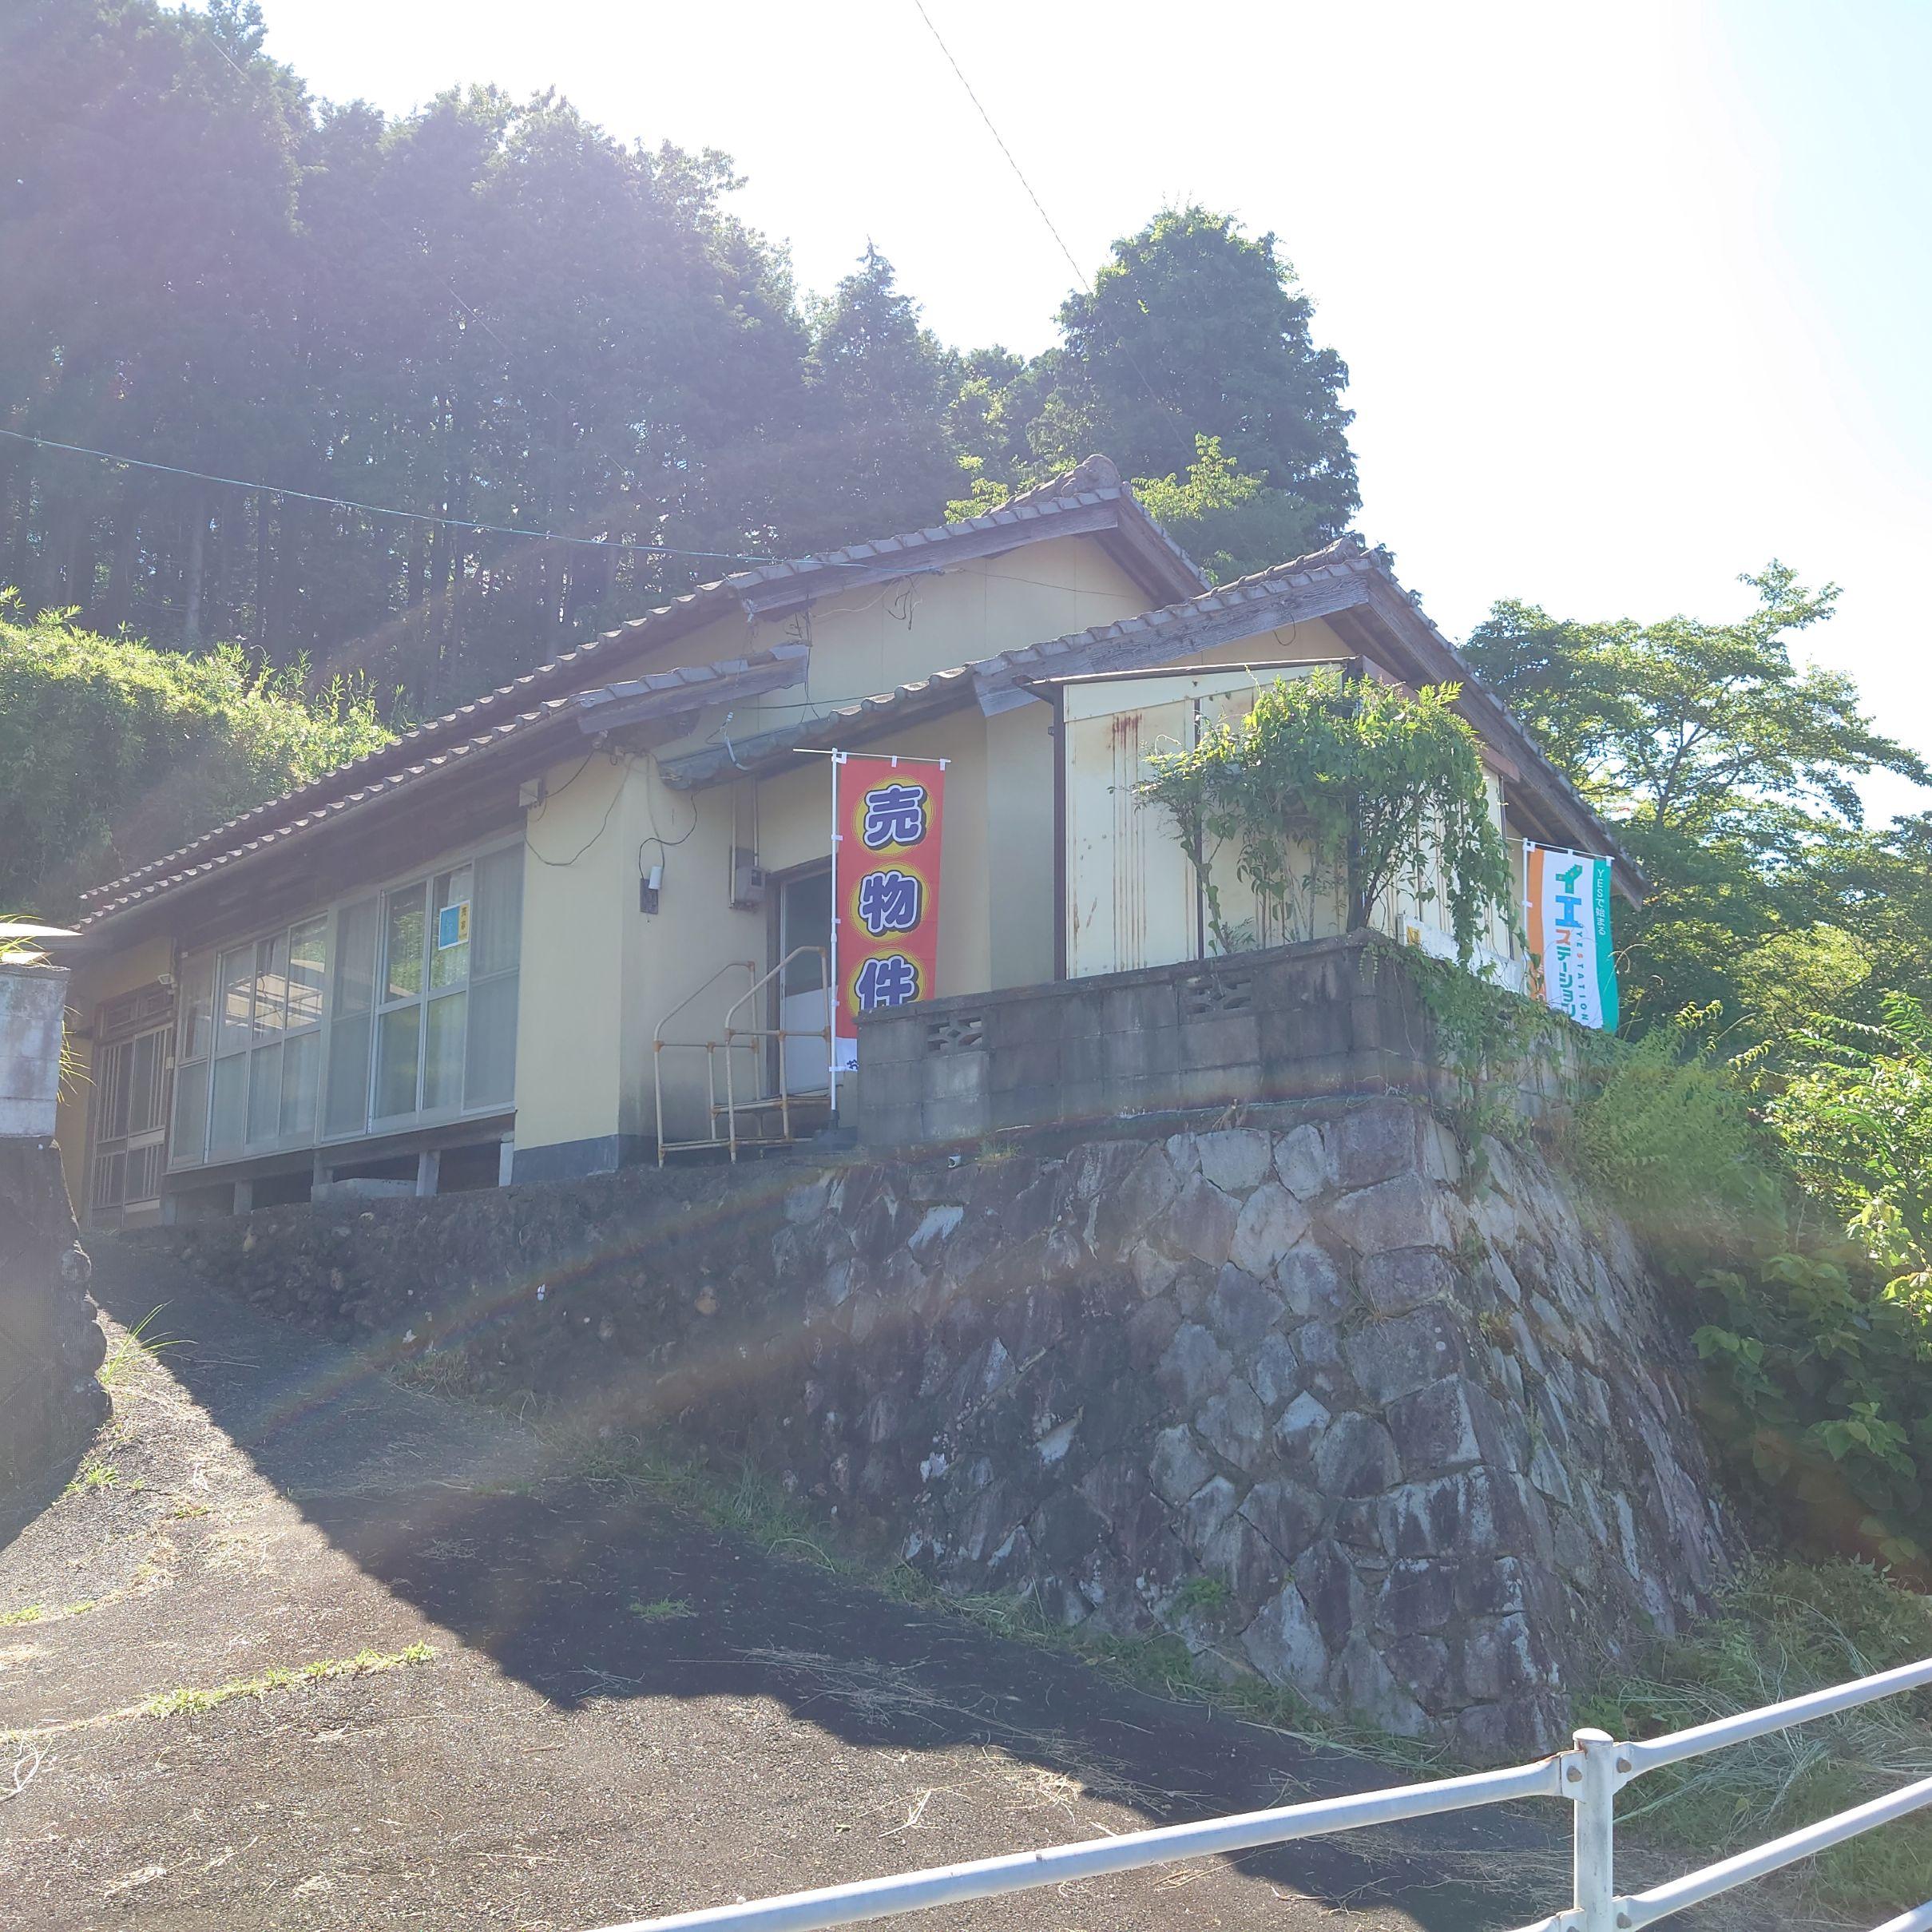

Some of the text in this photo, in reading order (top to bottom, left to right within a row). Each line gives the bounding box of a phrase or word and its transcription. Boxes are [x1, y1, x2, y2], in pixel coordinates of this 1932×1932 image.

[856, 784, 926, 1011] 売物件
[1596, 868, 1607, 935] YESで始まる
